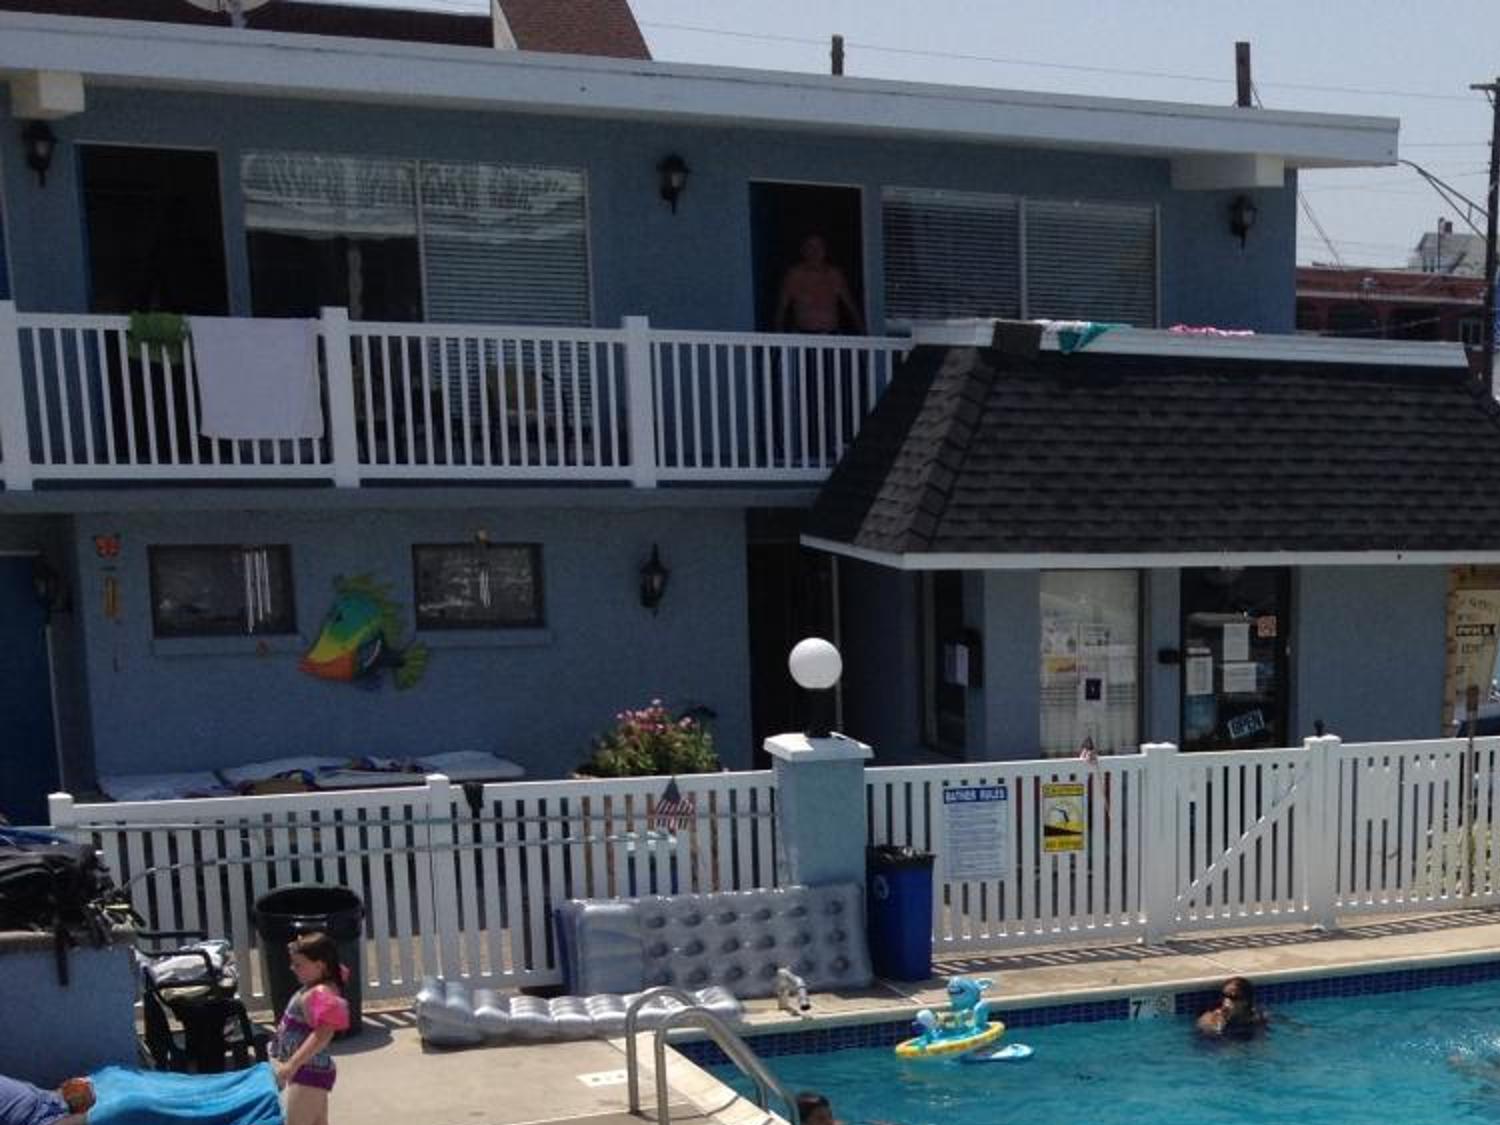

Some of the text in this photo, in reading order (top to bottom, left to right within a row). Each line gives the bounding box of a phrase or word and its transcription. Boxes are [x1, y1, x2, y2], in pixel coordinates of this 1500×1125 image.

[945, 787, 1005, 802] BATHER RULES
[1131, 1000, 1143, 1018] 7
